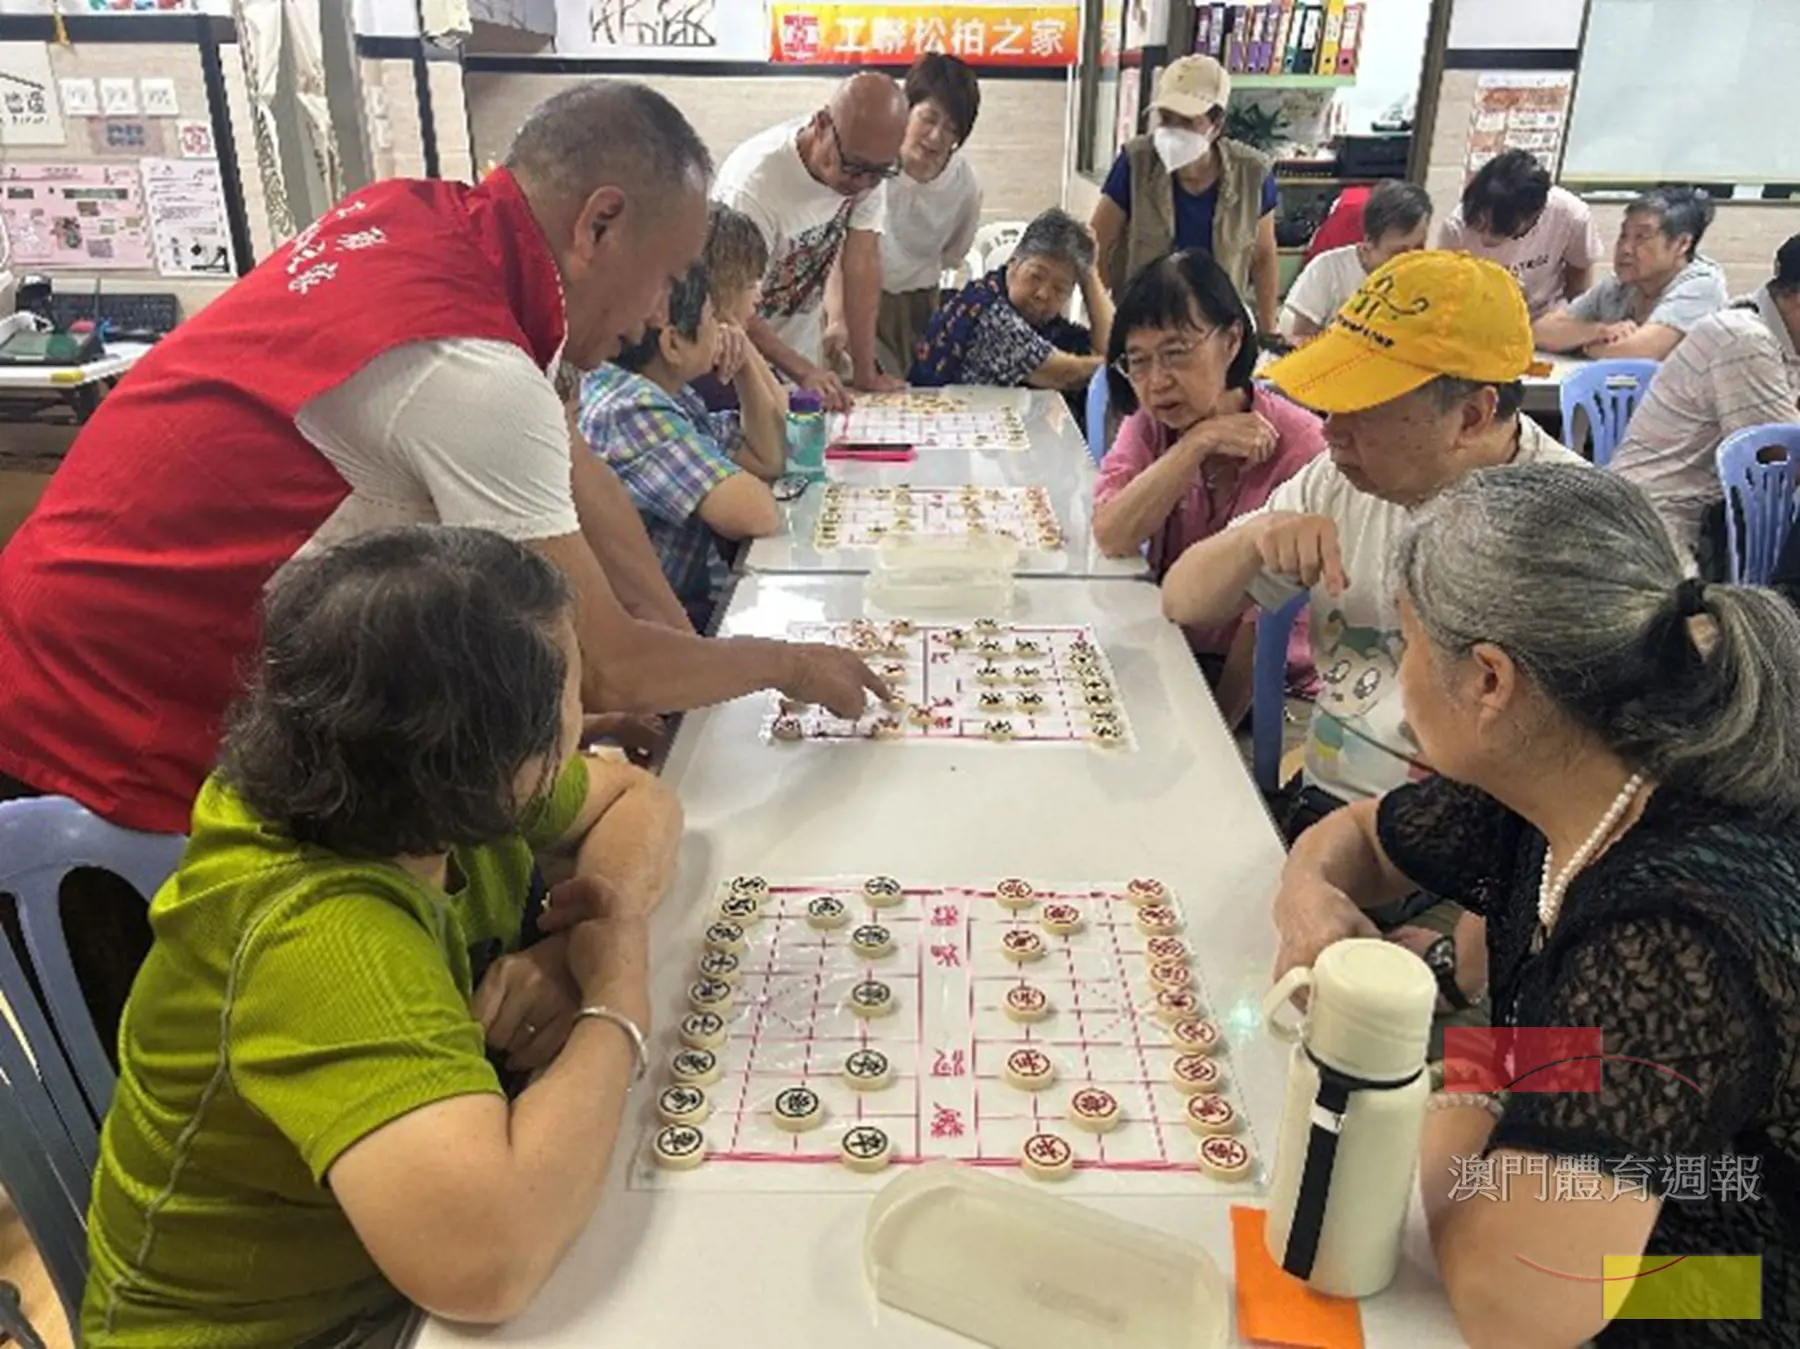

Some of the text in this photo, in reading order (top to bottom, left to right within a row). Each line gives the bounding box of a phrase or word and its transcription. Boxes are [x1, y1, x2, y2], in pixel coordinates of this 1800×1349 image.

[834, 16, 1066, 58] 工聯松柏之家
